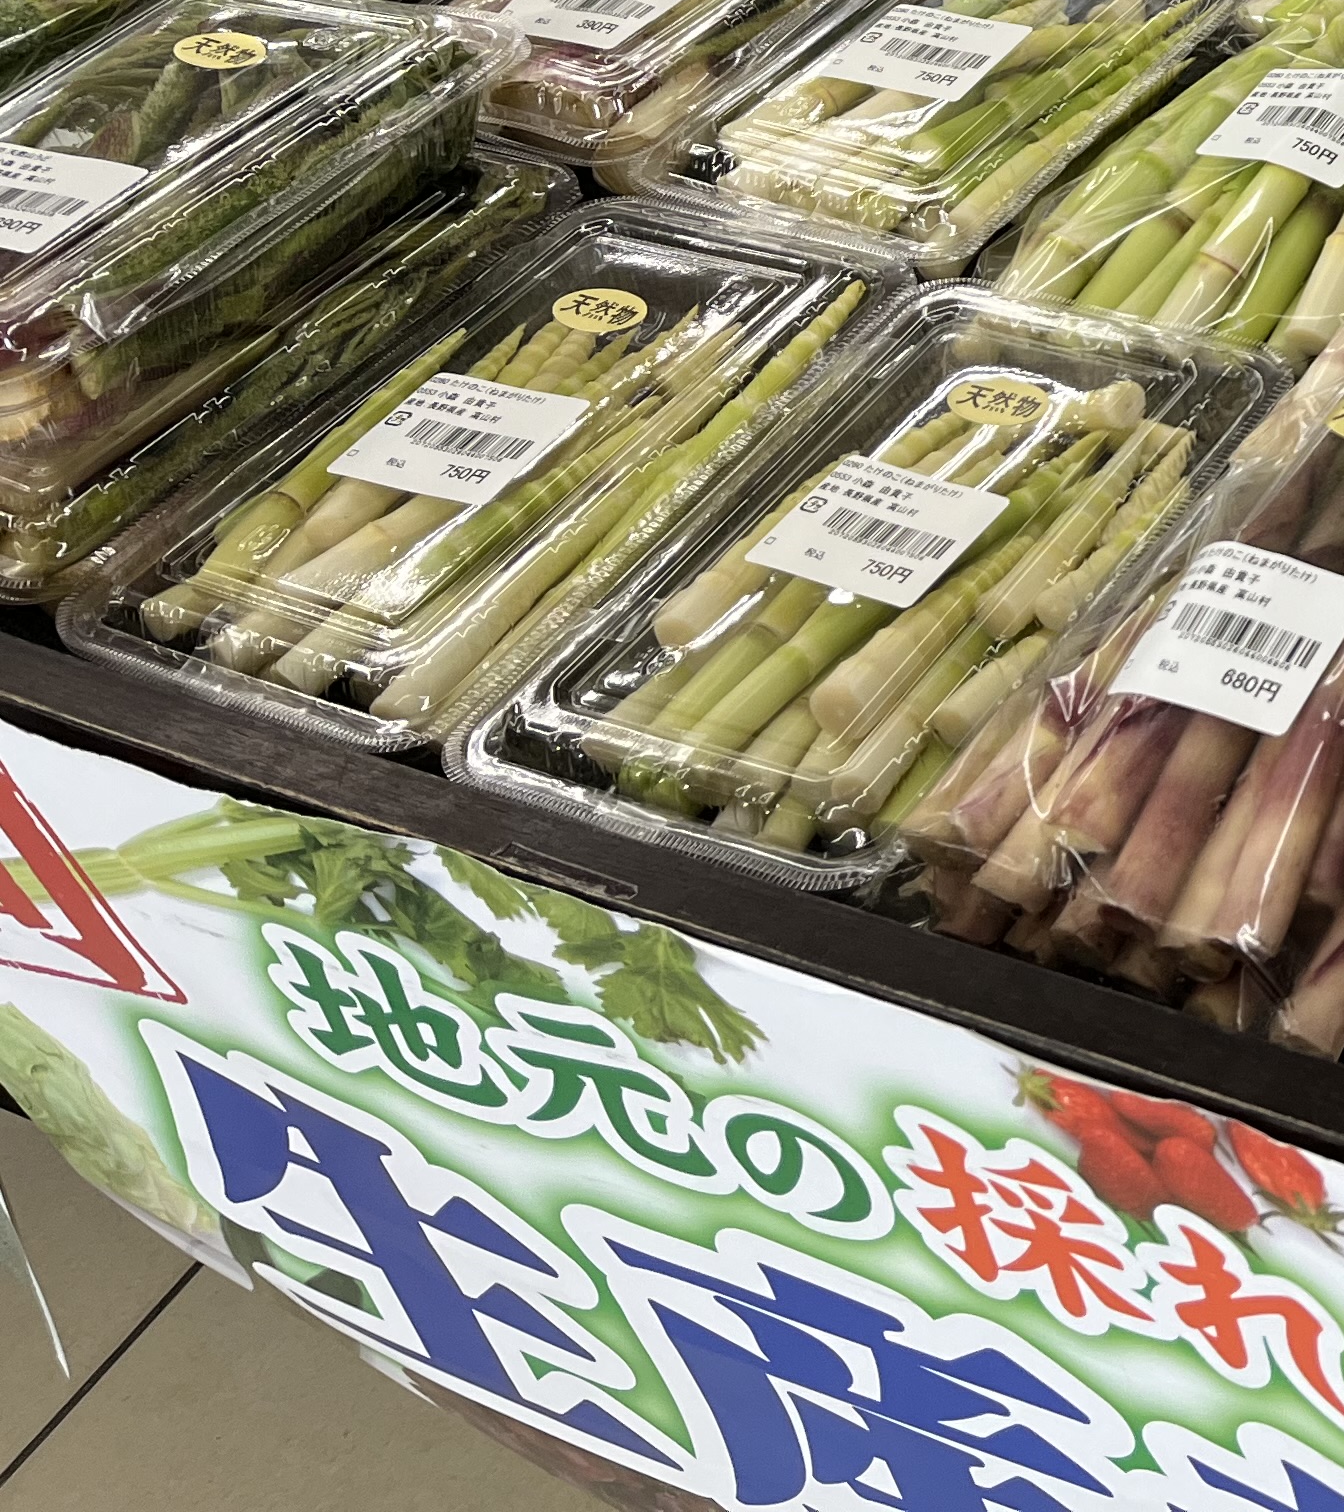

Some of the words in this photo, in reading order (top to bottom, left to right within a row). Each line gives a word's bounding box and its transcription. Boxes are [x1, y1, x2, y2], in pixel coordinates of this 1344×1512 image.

[576, 19, 620, 34] 390円
[914, 69, 959, 87] 750円
[1291, 137, 1339, 165] 750円
[560, 294, 640, 325] 天然物
[956, 384, 1043, 418] 天然物
[439, 463, 492, 486] 750円
[860, 558, 914, 585] 750円
[1220, 668, 1283, 704] 680円
